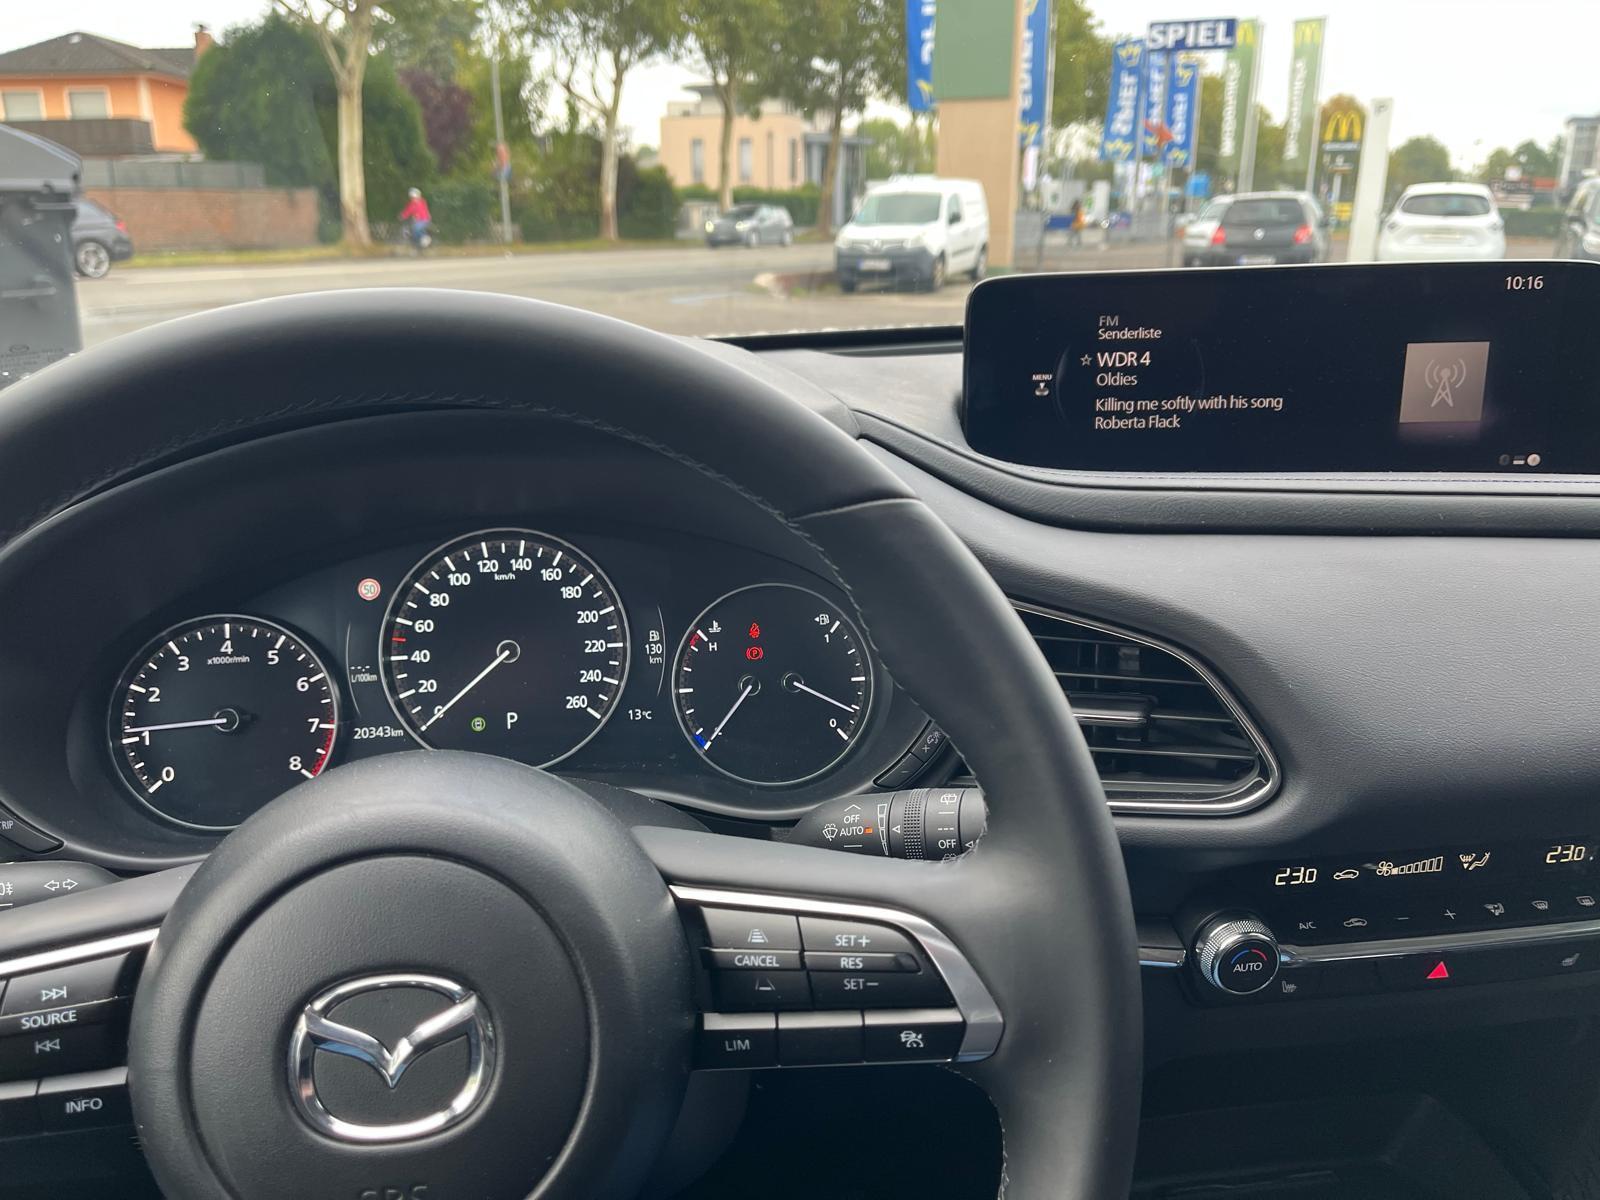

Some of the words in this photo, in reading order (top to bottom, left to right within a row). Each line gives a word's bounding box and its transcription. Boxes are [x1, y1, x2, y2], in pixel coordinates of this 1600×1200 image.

[1151, 21, 1233, 48] SPIEL
[1505, 275, 1544, 290] 10:16
[1098, 315, 1119, 327] FM
[1098, 328, 1162, 340] Senderliste
[1097, 351, 1138, 368] WDR
[1139, 351, 1151, 366] 4
[1032, 373, 1053, 381] MENU
[1096, 371, 1138, 386] Oldies
[1095, 397, 1135, 414] Killing
[1136, 400, 1159, 411] me
[1161, 395, 1197, 413] softly
[1198, 394, 1228, 410] with
[1229, 394, 1249, 409] his
[1250, 397, 1284, 411] song
[1095, 415, 1146, 430] Roberta
[1148, 413, 1181, 429] Flack
[476, 557, 499, 575] 120
[509, 557, 533, 572] 140
[447, 570, 471, 586] 100
[492, 571, 516, 581] km/h
[540, 565, 563, 582] 160
[363, 583, 376, 595] 50
[560, 583, 584, 599] 180
[428, 591, 450, 607] 80
[576, 610, 600, 624] 200
[414, 619, 435, 633] 60
[584, 639, 606, 653] 220
[824, 633, 832, 644] 1
[219, 639, 234, 655] 4
[644, 643, 663, 655] 130
[708, 641, 718, 652] H
[177, 655, 190, 672] 3
[206, 655, 251, 665] x1000r/min
[267, 648, 280, 665] 5
[410, 649, 431, 663] 40
[649, 655, 664, 666] km
[351, 673, 378, 683] L/100km
[579, 668, 602, 683] 240
[296, 676, 310, 692] 6
[418, 679, 438, 693] 20
[148, 686, 161, 703] 2
[565, 694, 589, 710] 260
[307, 717, 319, 732] 7
[506, 711, 518, 730] P
[829, 718, 837, 728] 0
[140, 730, 151, 746] 1
[289, 755, 303, 772] 8
[161, 766, 175, 783] 0
[843, 813, 861, 824] OFF
[839, 824, 865, 837] AUTO
[937, 838, 957, 849] OFF
[1299, 921, 1317, 930] A/C
[734, 954, 780, 968] CANCEL
[839, 955, 864, 969] RES
[1232, 961, 1263, 973] AUTO
[20, 1009, 78, 1029] SOURCE
[725, 1039, 751, 1052] LIM
[65, 1097, 103, 1114] INFO
